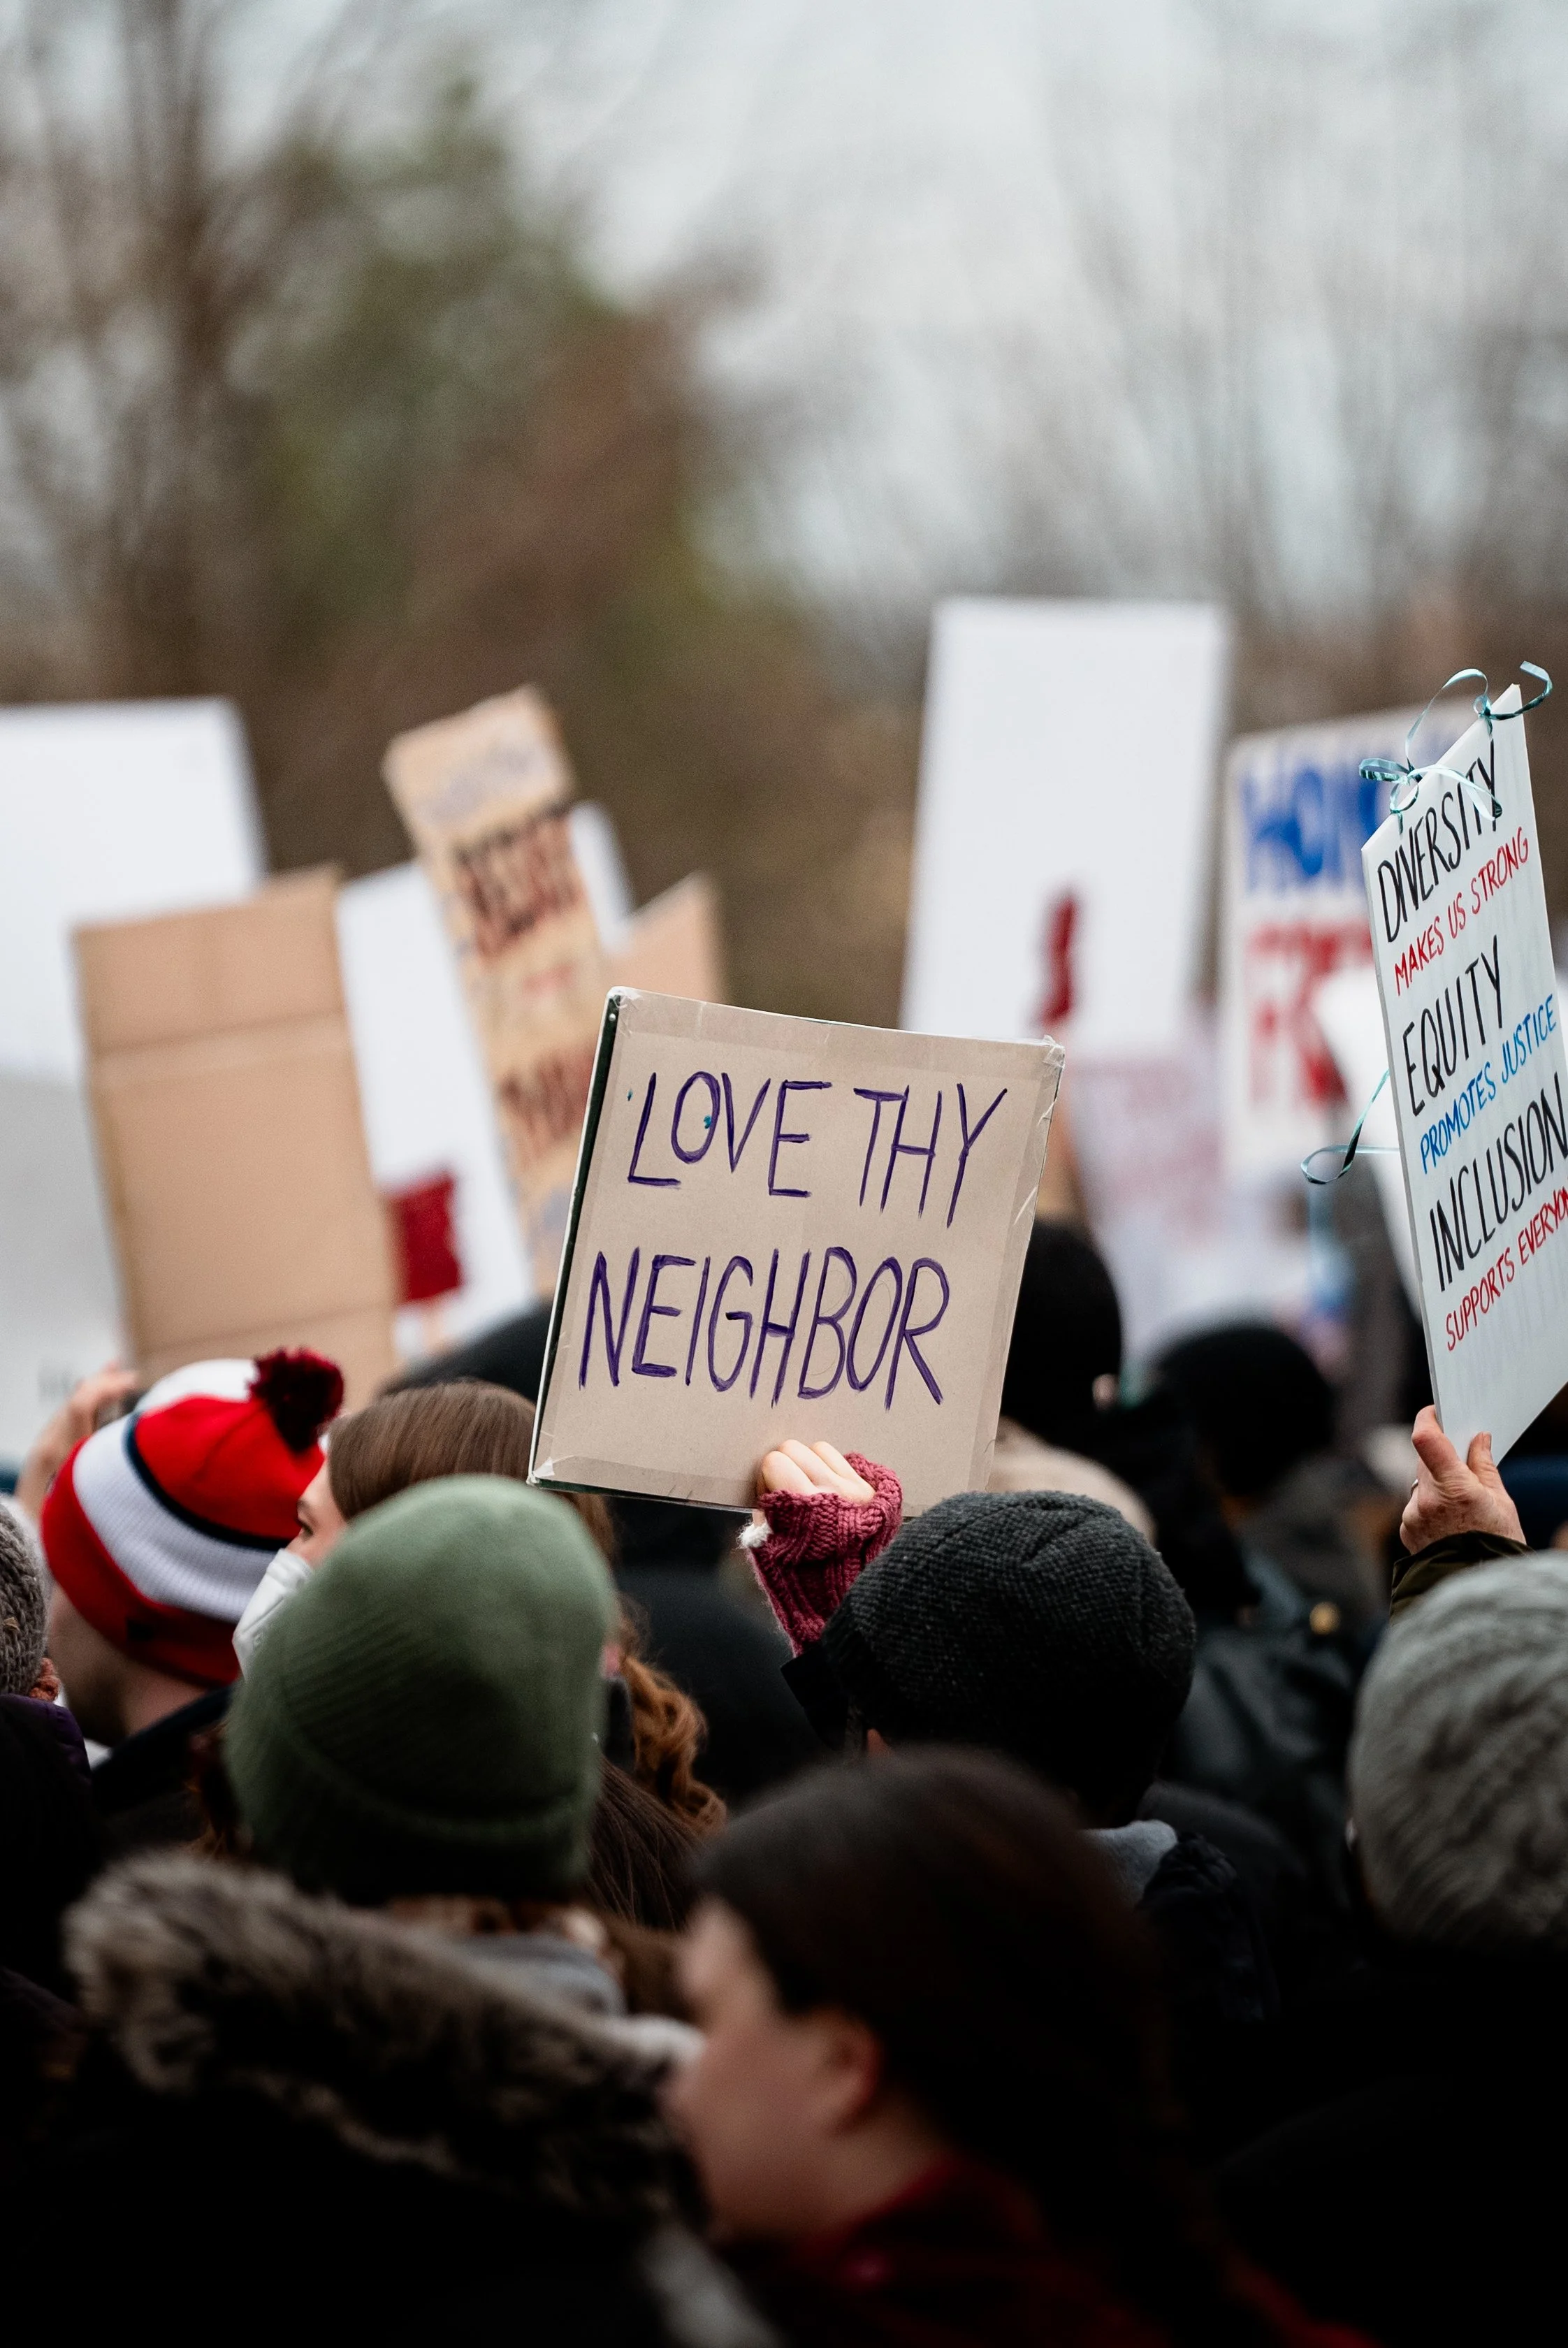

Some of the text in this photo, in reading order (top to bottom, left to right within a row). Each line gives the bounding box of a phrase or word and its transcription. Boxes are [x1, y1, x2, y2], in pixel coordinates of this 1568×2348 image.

[1377, 738, 1497, 943] DIVERSITY
[1394, 826, 1529, 997] MAKES US STRONG
[1402, 934, 1502, 1117] EQUITY
[1420, 993, 1556, 1175] PROMOTES JUSTICE
[627, 1071, 832, 1197] LOVE
[854, 1083, 1008, 1228] THY
[1430, 1071, 1568, 1292] INCLUSION
[578, 1246, 950, 1412] NEIGHBOR
[1446, 1247, 1515, 1351] SUPPORTS
